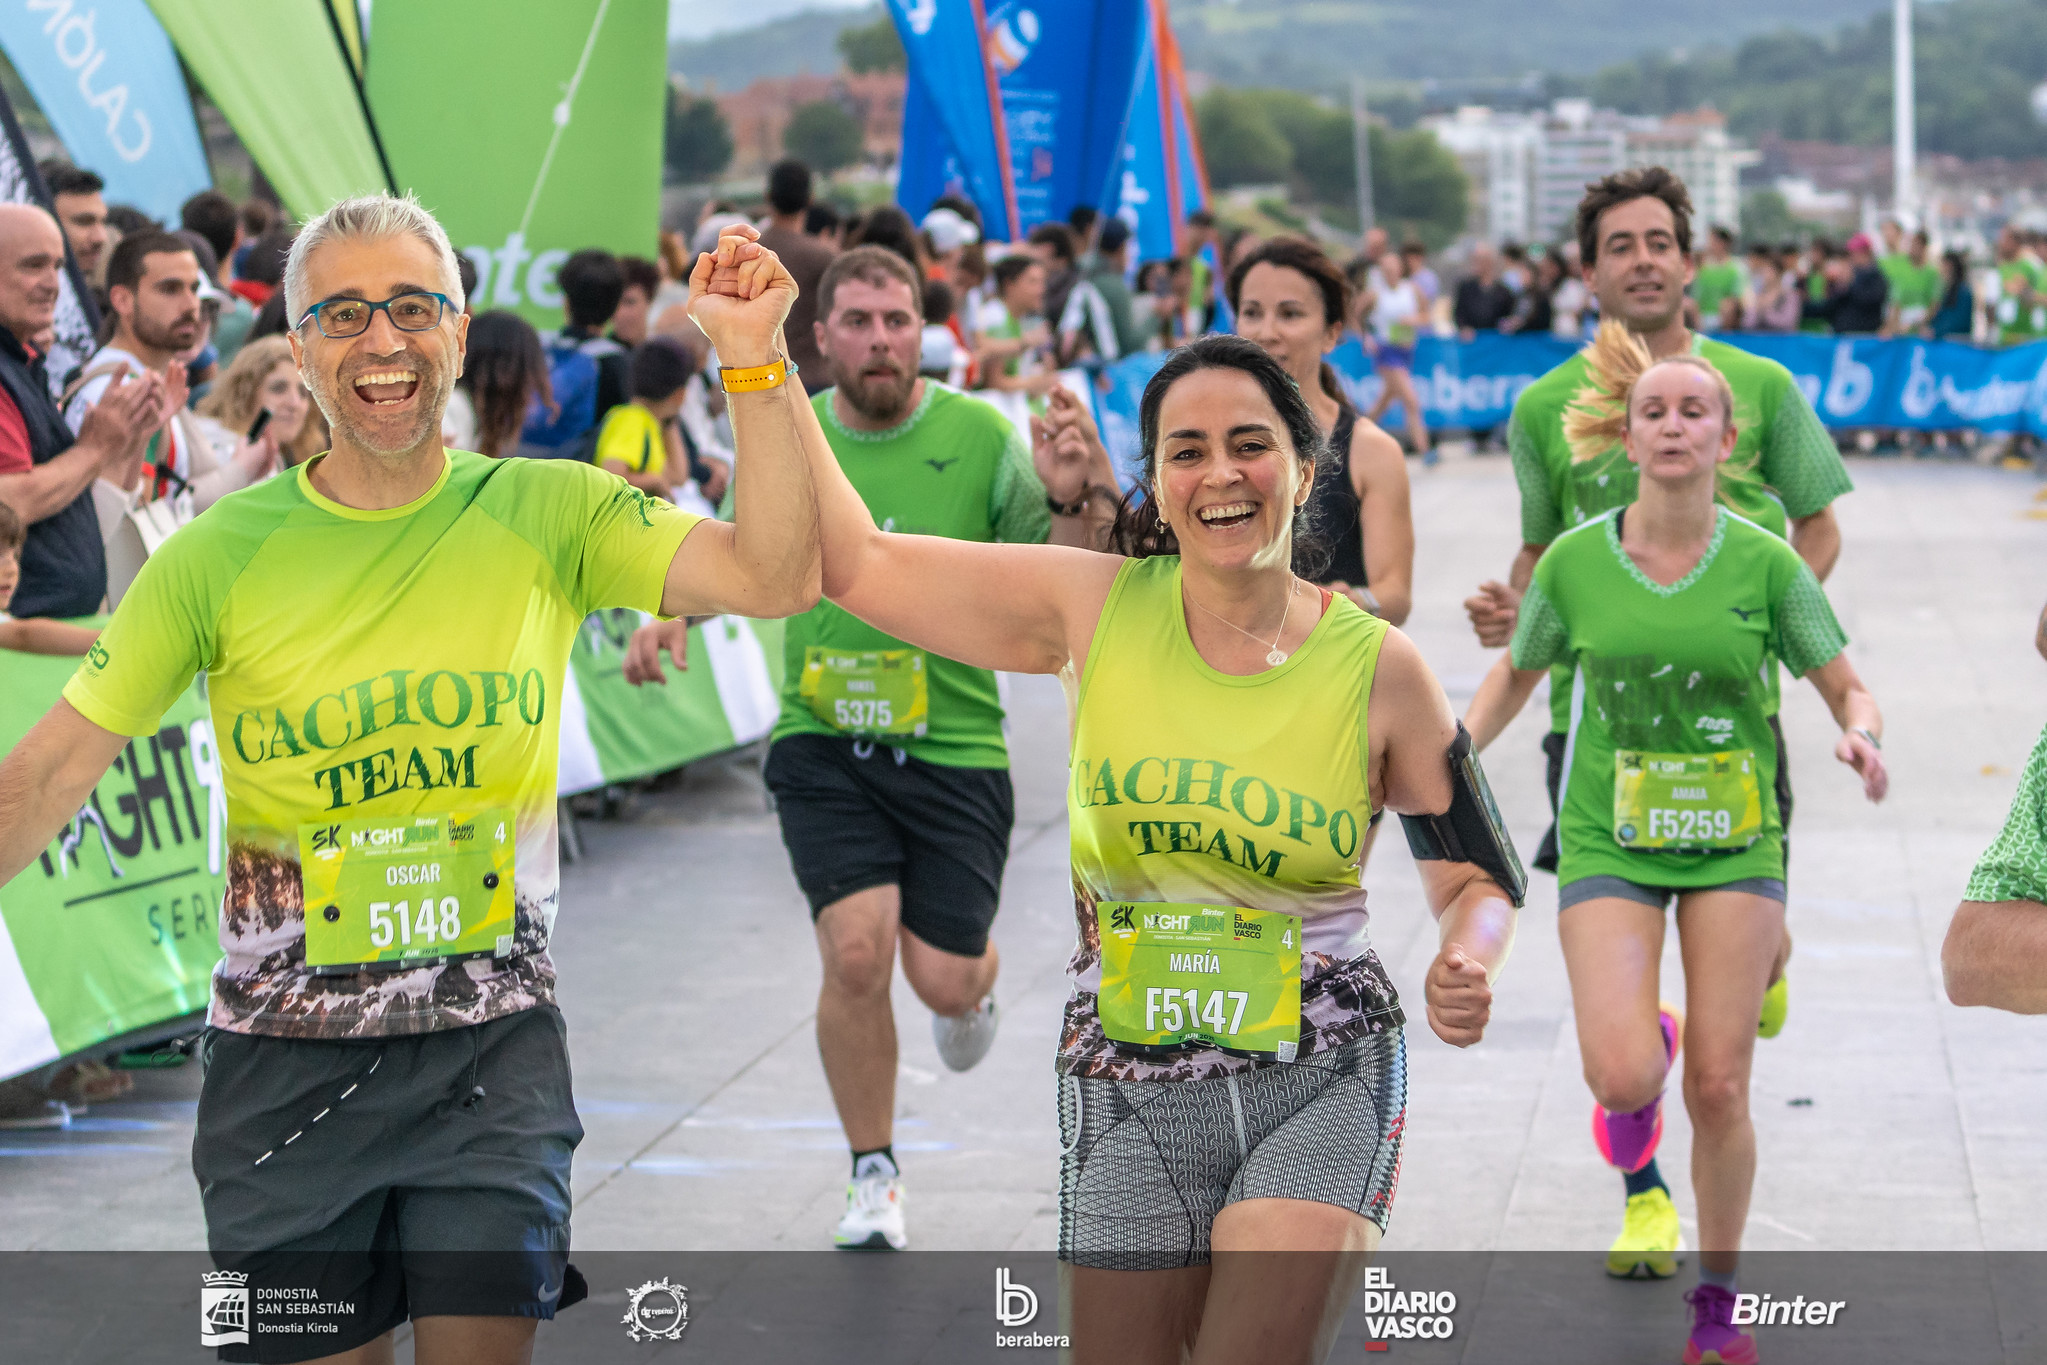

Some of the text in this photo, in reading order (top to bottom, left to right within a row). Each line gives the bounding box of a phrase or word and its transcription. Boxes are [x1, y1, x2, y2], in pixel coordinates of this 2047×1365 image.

[232, 668, 545, 764] CACHOPO
[834, 699, 893, 728] 5375
[314, 745, 482, 811] TEAM
[1741, 759, 1750, 774] 4
[1671, 787, 1709, 800] AMAIA
[1075, 757, 1358, 859] CACHOPO
[494, 821, 507, 845] 4
[1648, 808, 1731, 840] F5259
[1128, 821, 1288, 879] TEAM
[386, 863, 441, 887] OSCAR
[369, 896, 461, 948] 5148
[1201, 908, 1226, 917] Binter
[1234, 914, 1244, 922] EL
[1234, 921, 1262, 932] DIARIO
[1234, 929, 1262, 939] VASCO
[1281, 929, 1293, 950] 4
[1169, 949, 1221, 974] MARÍA
[1146, 987, 1249, 1036] F5147
[1183, 1032, 1199, 1041] JUN
